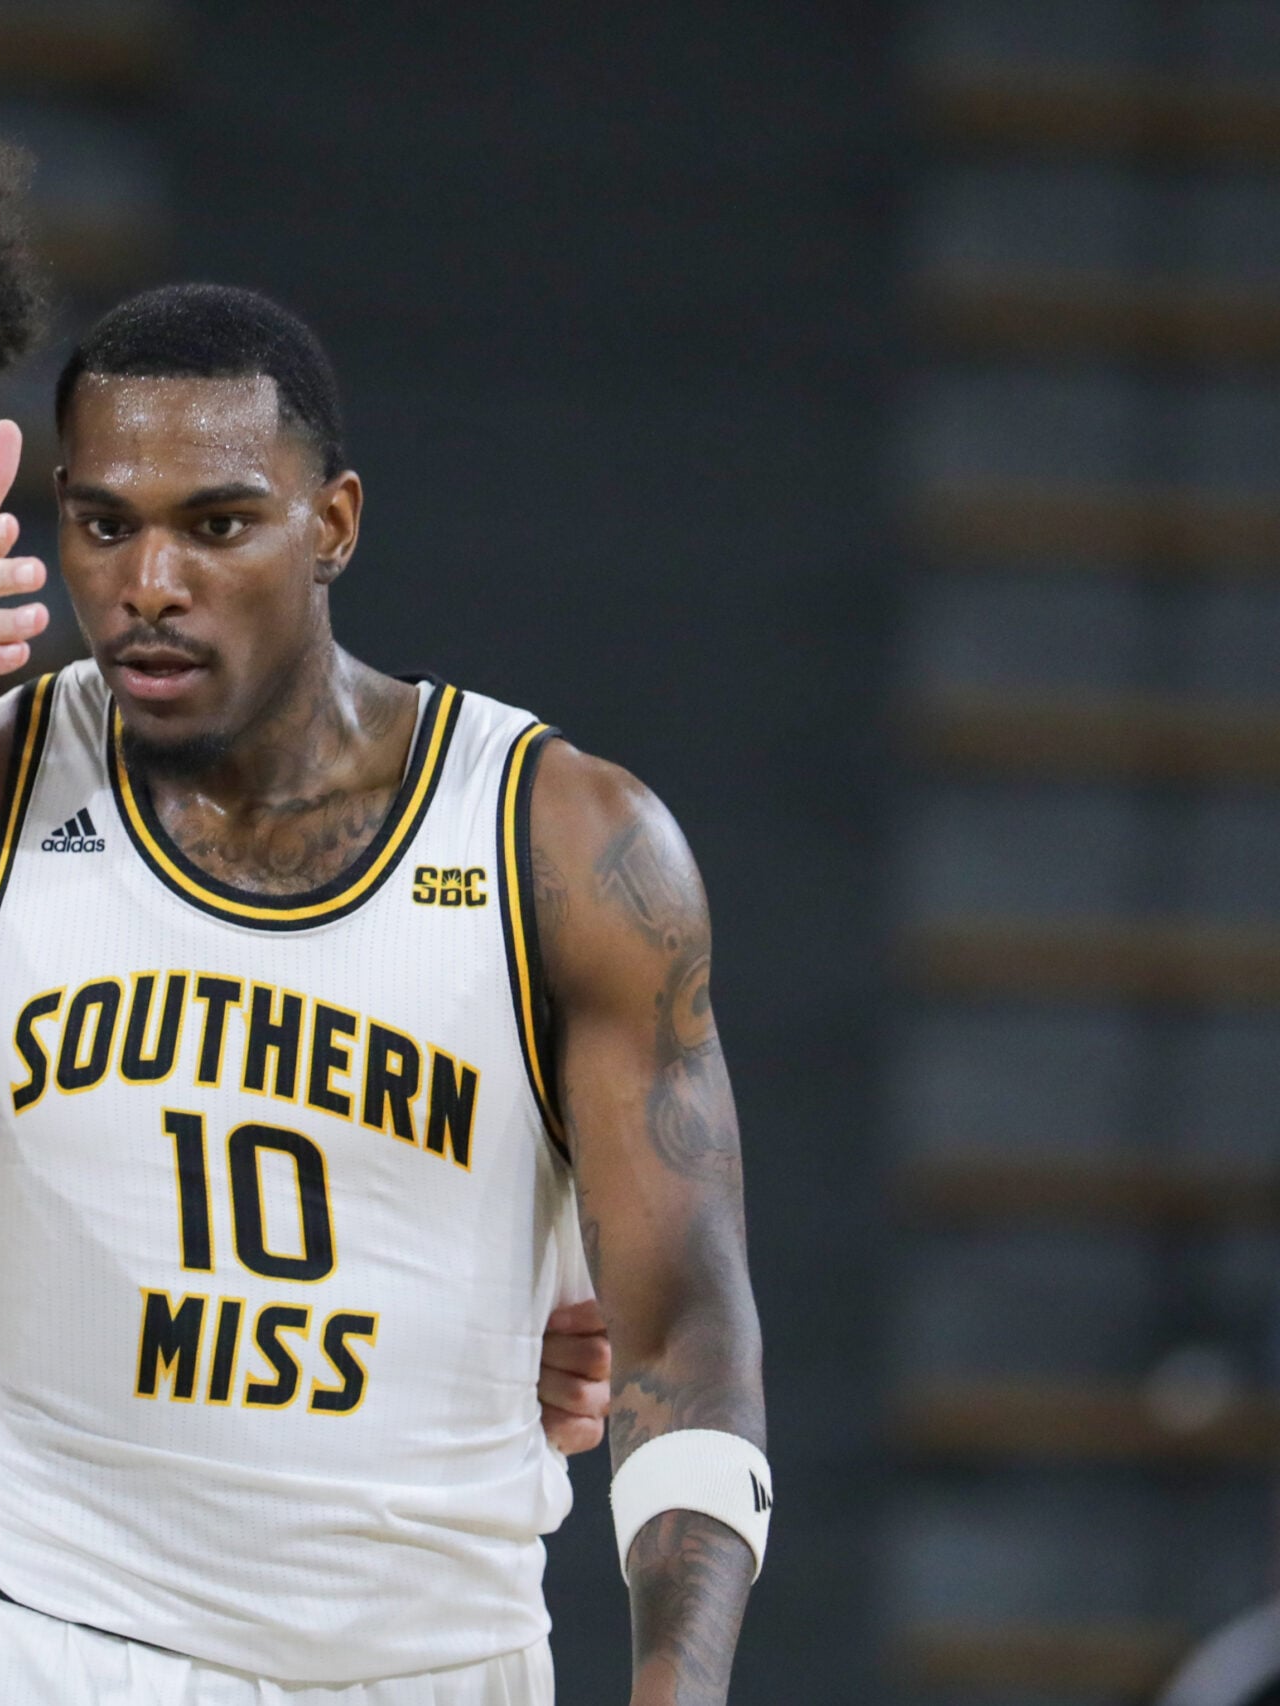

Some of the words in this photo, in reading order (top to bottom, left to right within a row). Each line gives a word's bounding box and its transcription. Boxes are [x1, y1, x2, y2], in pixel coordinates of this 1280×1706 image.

[41, 836, 106, 853] adidas
[412, 865, 488, 909] SBC
[10, 970, 481, 1173] SOUTHERN
[161, 1106, 339, 1284] 10
[133, 1287, 381, 1417] MISS
